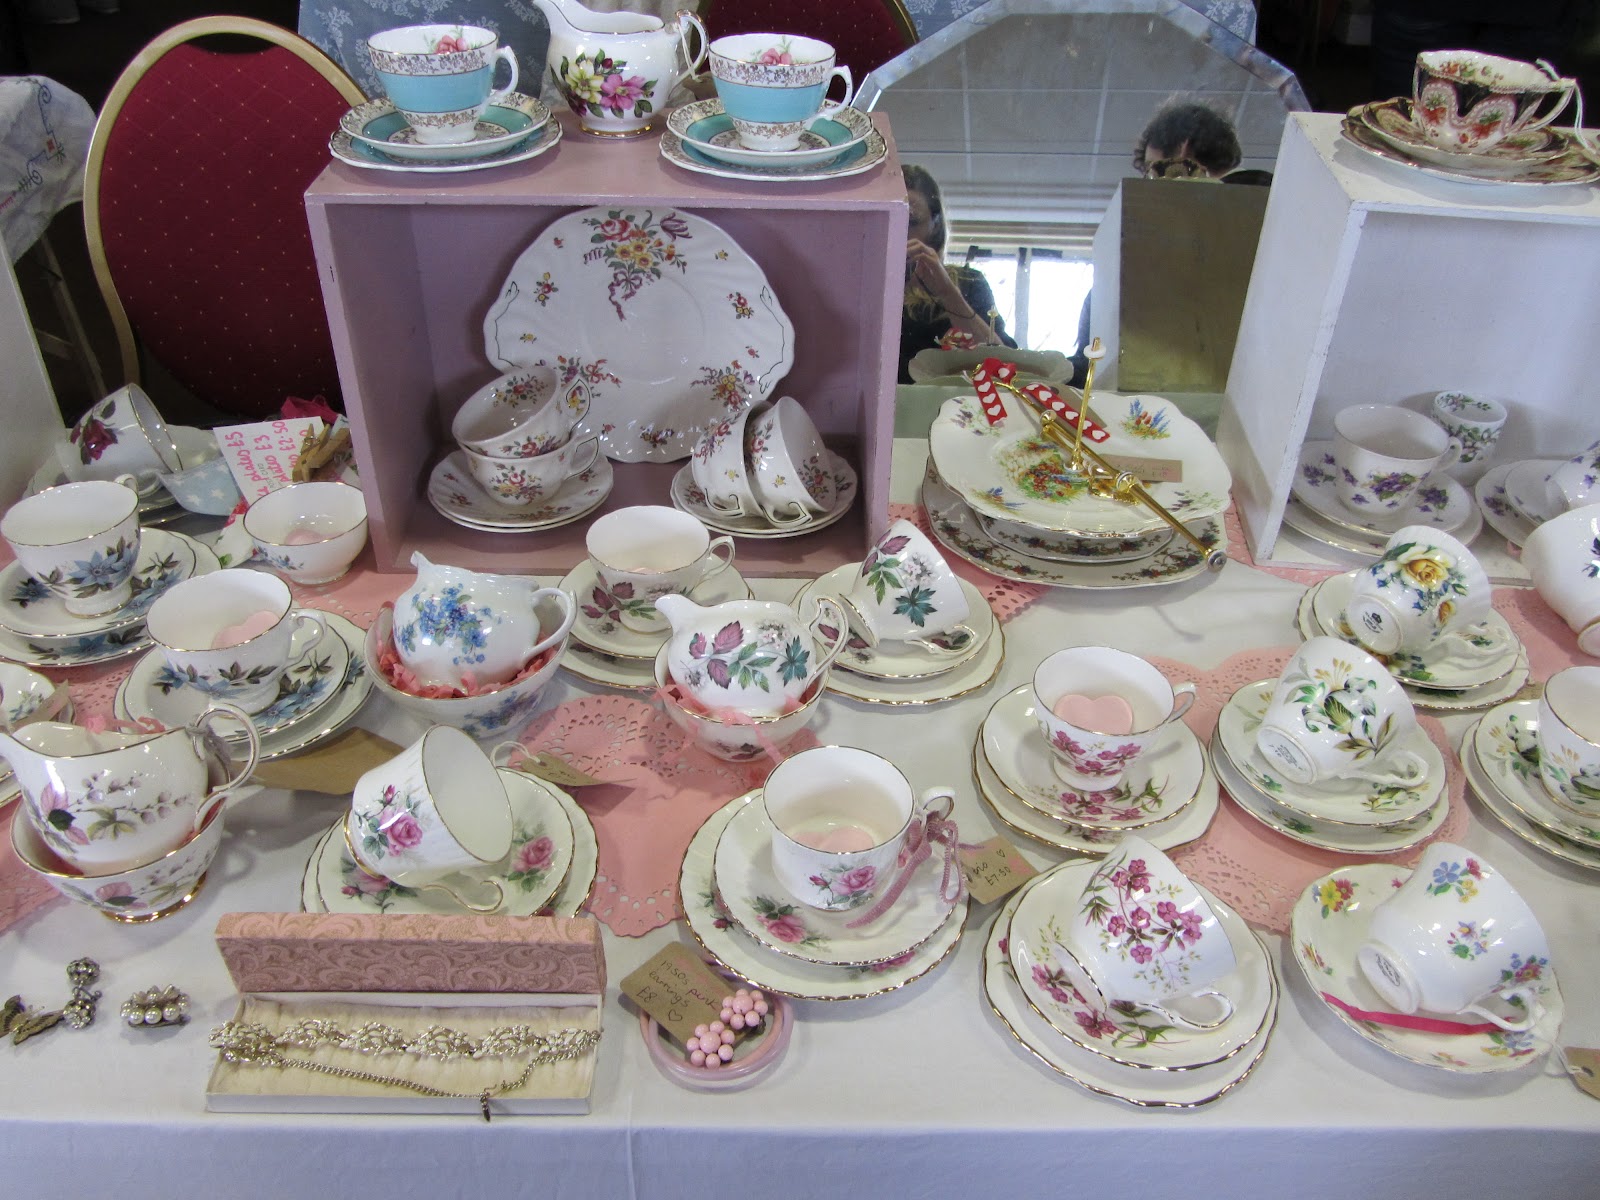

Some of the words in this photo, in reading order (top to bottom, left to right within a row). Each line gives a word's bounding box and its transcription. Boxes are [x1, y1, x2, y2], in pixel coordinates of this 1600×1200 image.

[225, 431, 245, 447] £5
[254, 434, 273, 450] £3
[636, 985, 658, 1003] £8
[648, 970, 690, 1008] earrings
[660, 960, 689, 985] 1950s
[686, 988, 719, 1010] pink
